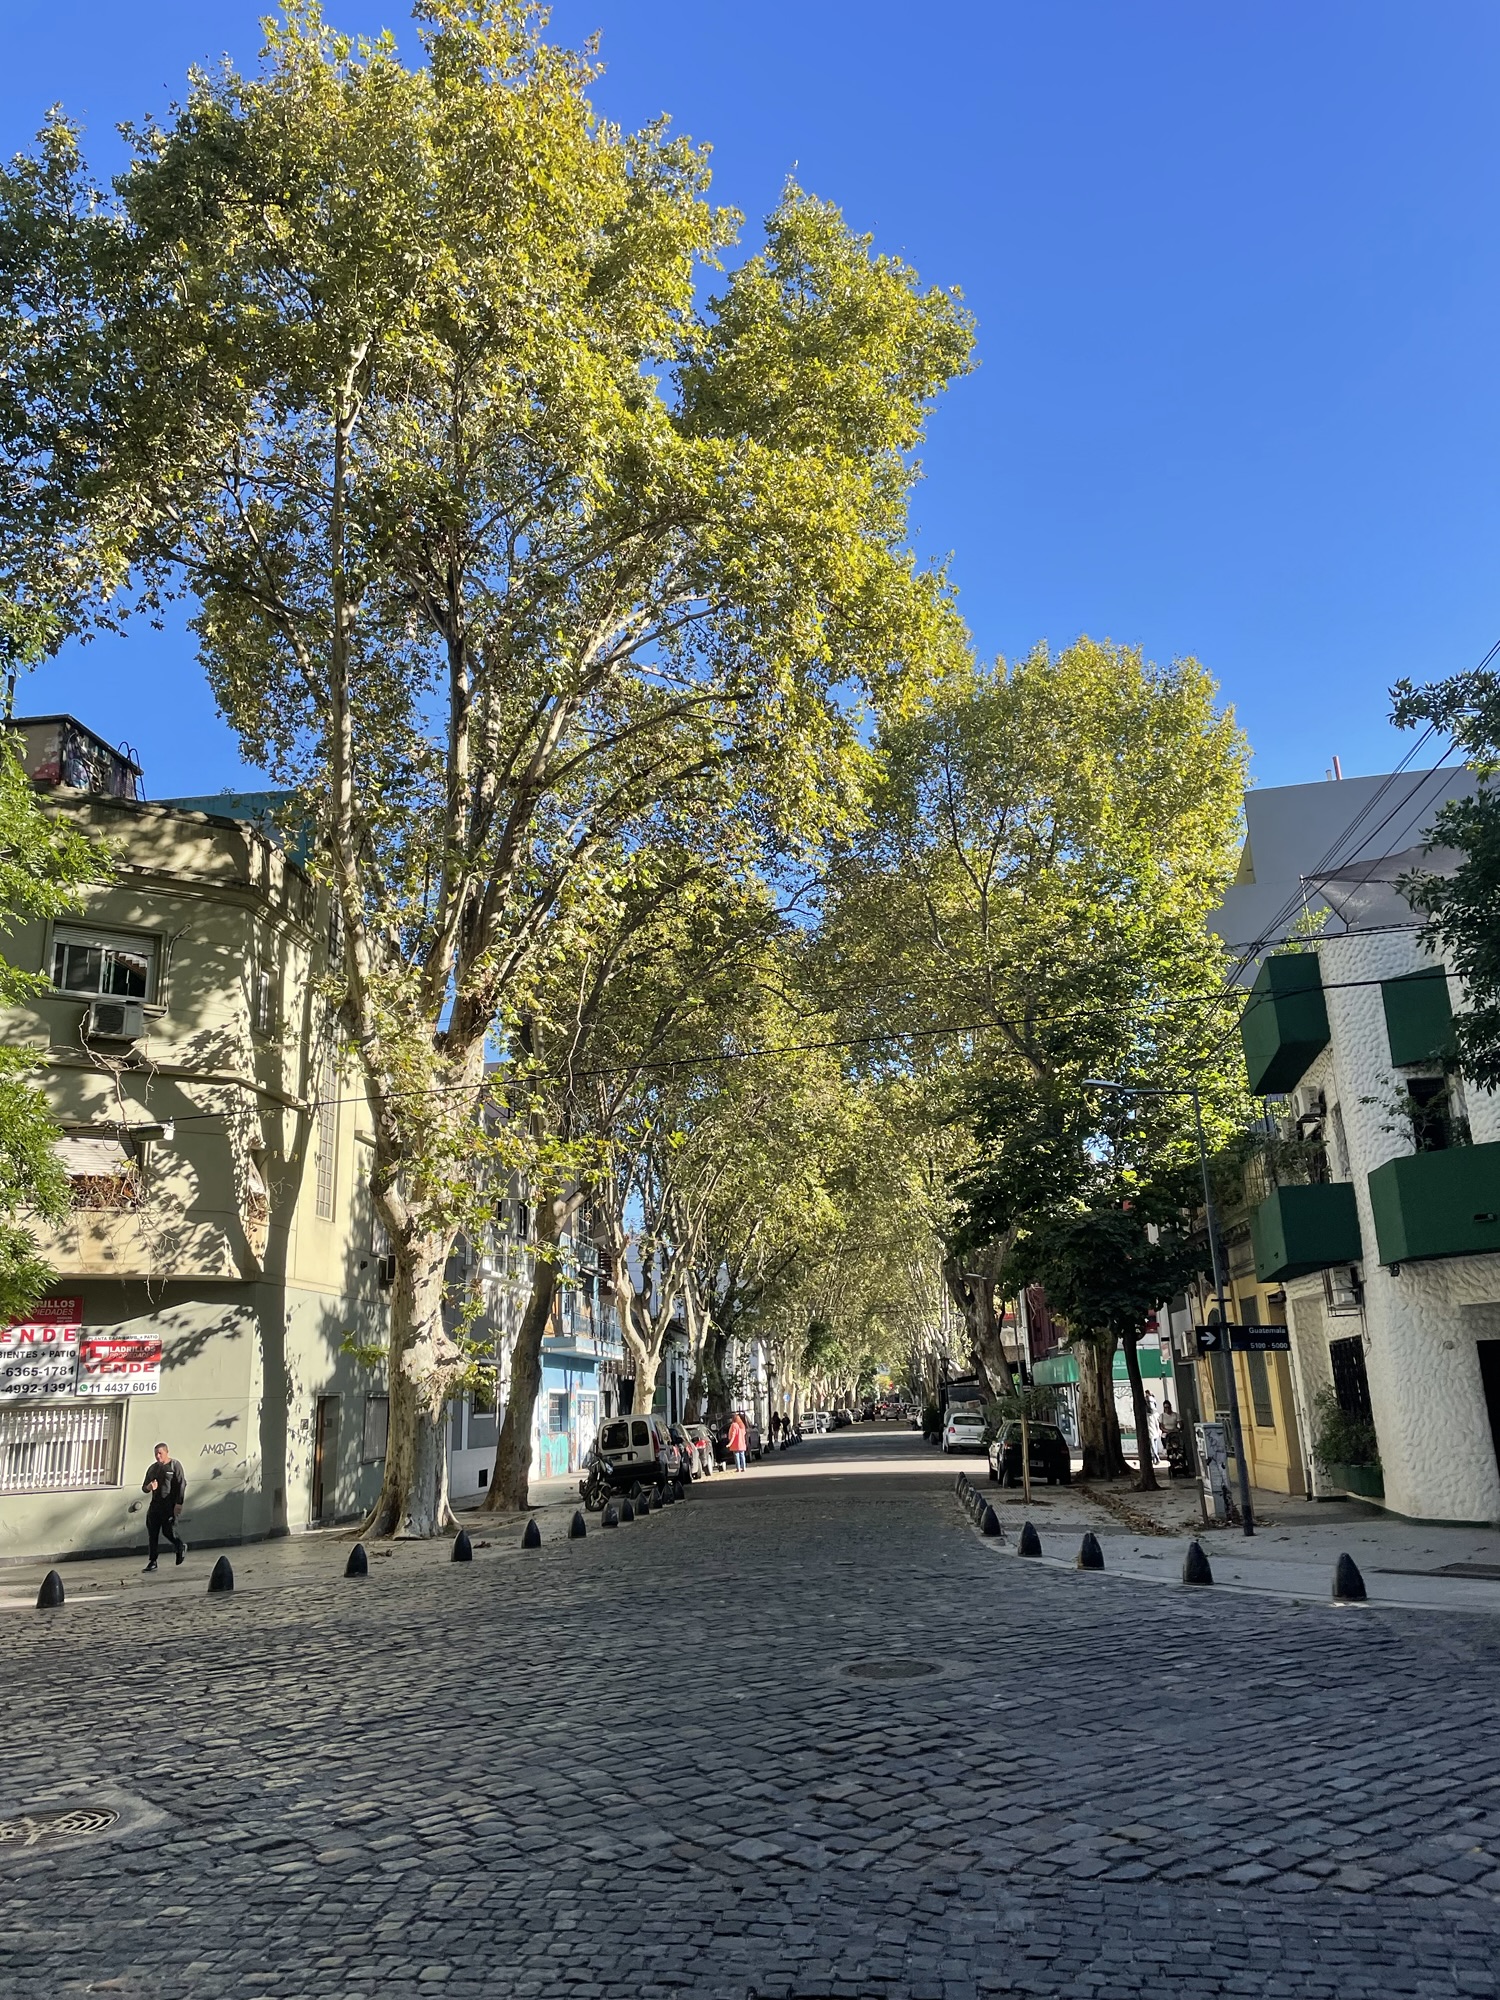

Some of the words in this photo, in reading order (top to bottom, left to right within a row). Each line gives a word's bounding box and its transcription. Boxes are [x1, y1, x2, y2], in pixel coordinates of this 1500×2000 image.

[36, 1300, 75, 1308] RILLOS
[31, 1308, 74, 1316] PIEDADES
[1, 1328, 76, 1342] ENDE
[49, 1350, 76, 1358] PATIO
[110, 1345, 156, 1353] LADRILLOS
[0, 1366, 74, 1377] -6365-1781
[84, 1363, 155, 1373] VENDE
[0, 1383, 74, 1394] -4992-1391
[89, 1384, 101, 1393] 11
[105, 1383, 130, 1392] 4437
[133, 1382, 157, 1392] 6016
